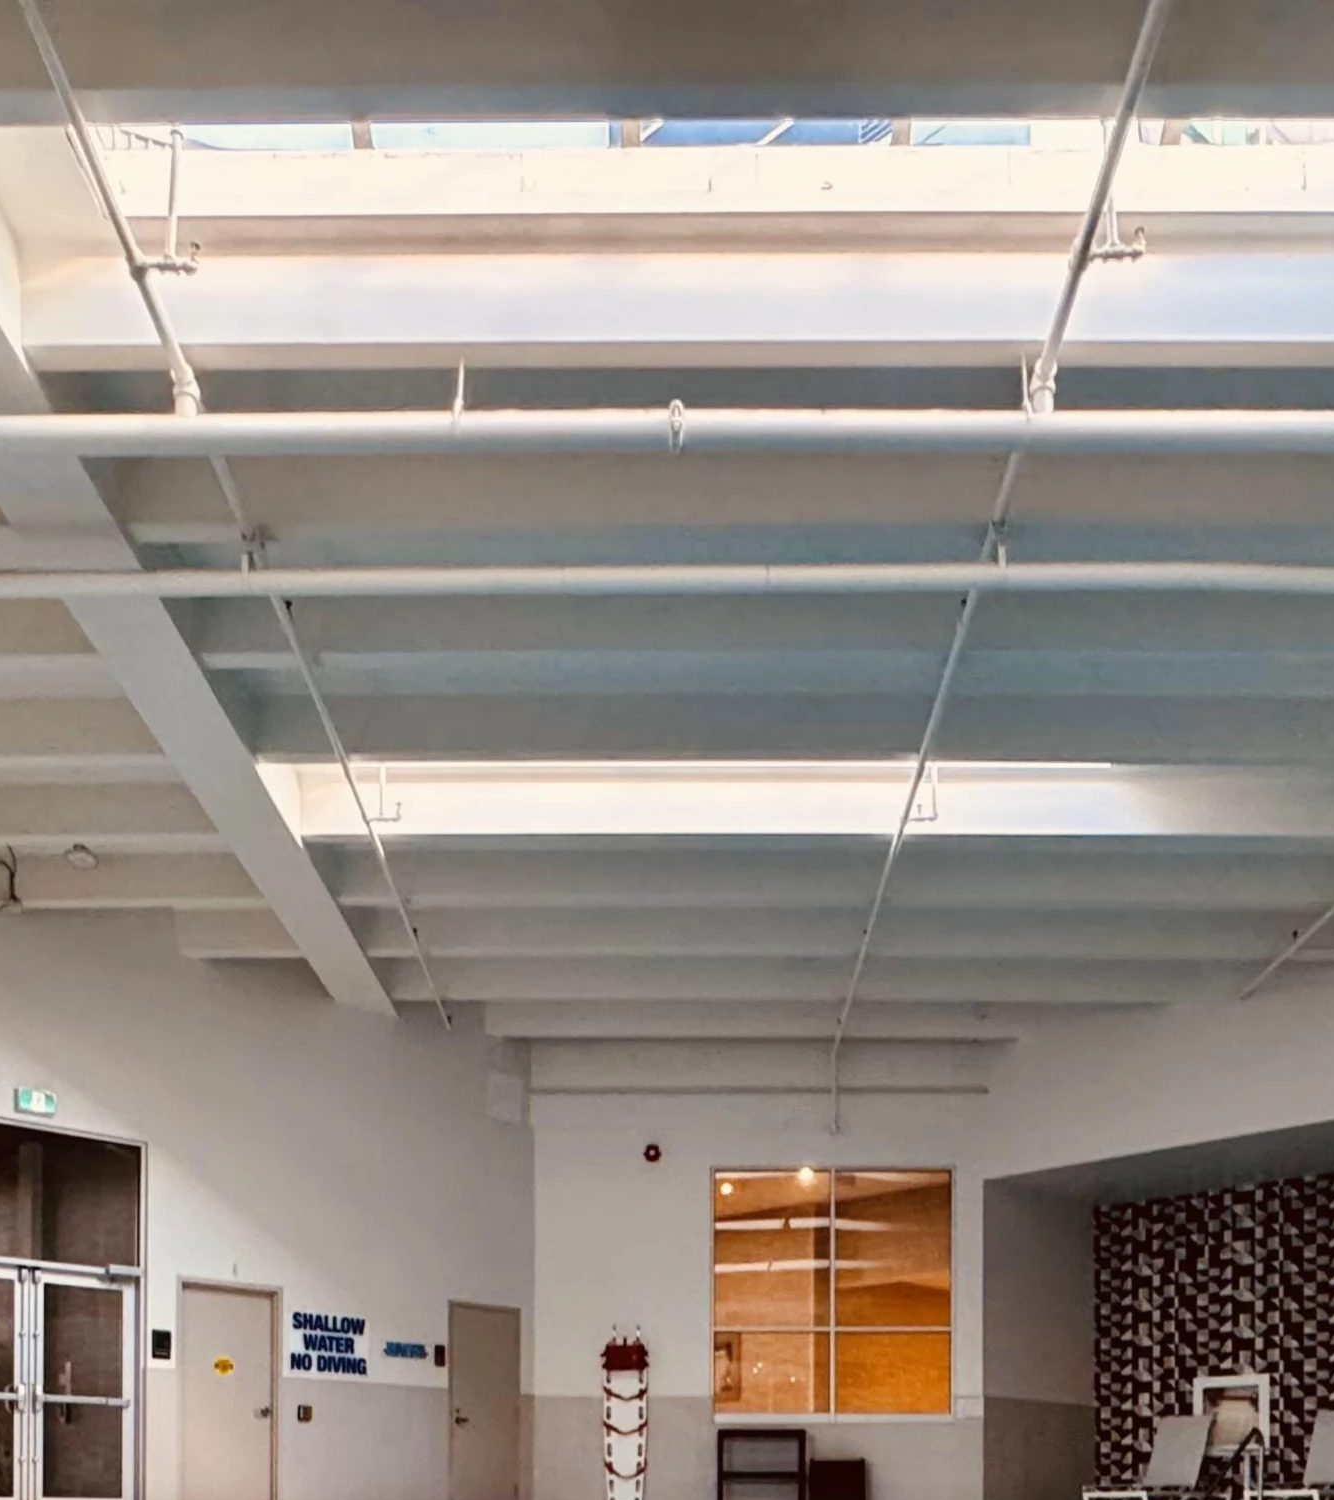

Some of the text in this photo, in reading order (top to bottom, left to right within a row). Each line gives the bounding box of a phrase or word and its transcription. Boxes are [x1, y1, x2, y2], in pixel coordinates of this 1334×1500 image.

[292, 1311, 366, 1336] SHALLOW
[303, 1333, 355, 1355] WATER
[290, 1352, 367, 1376] NO DIVING
